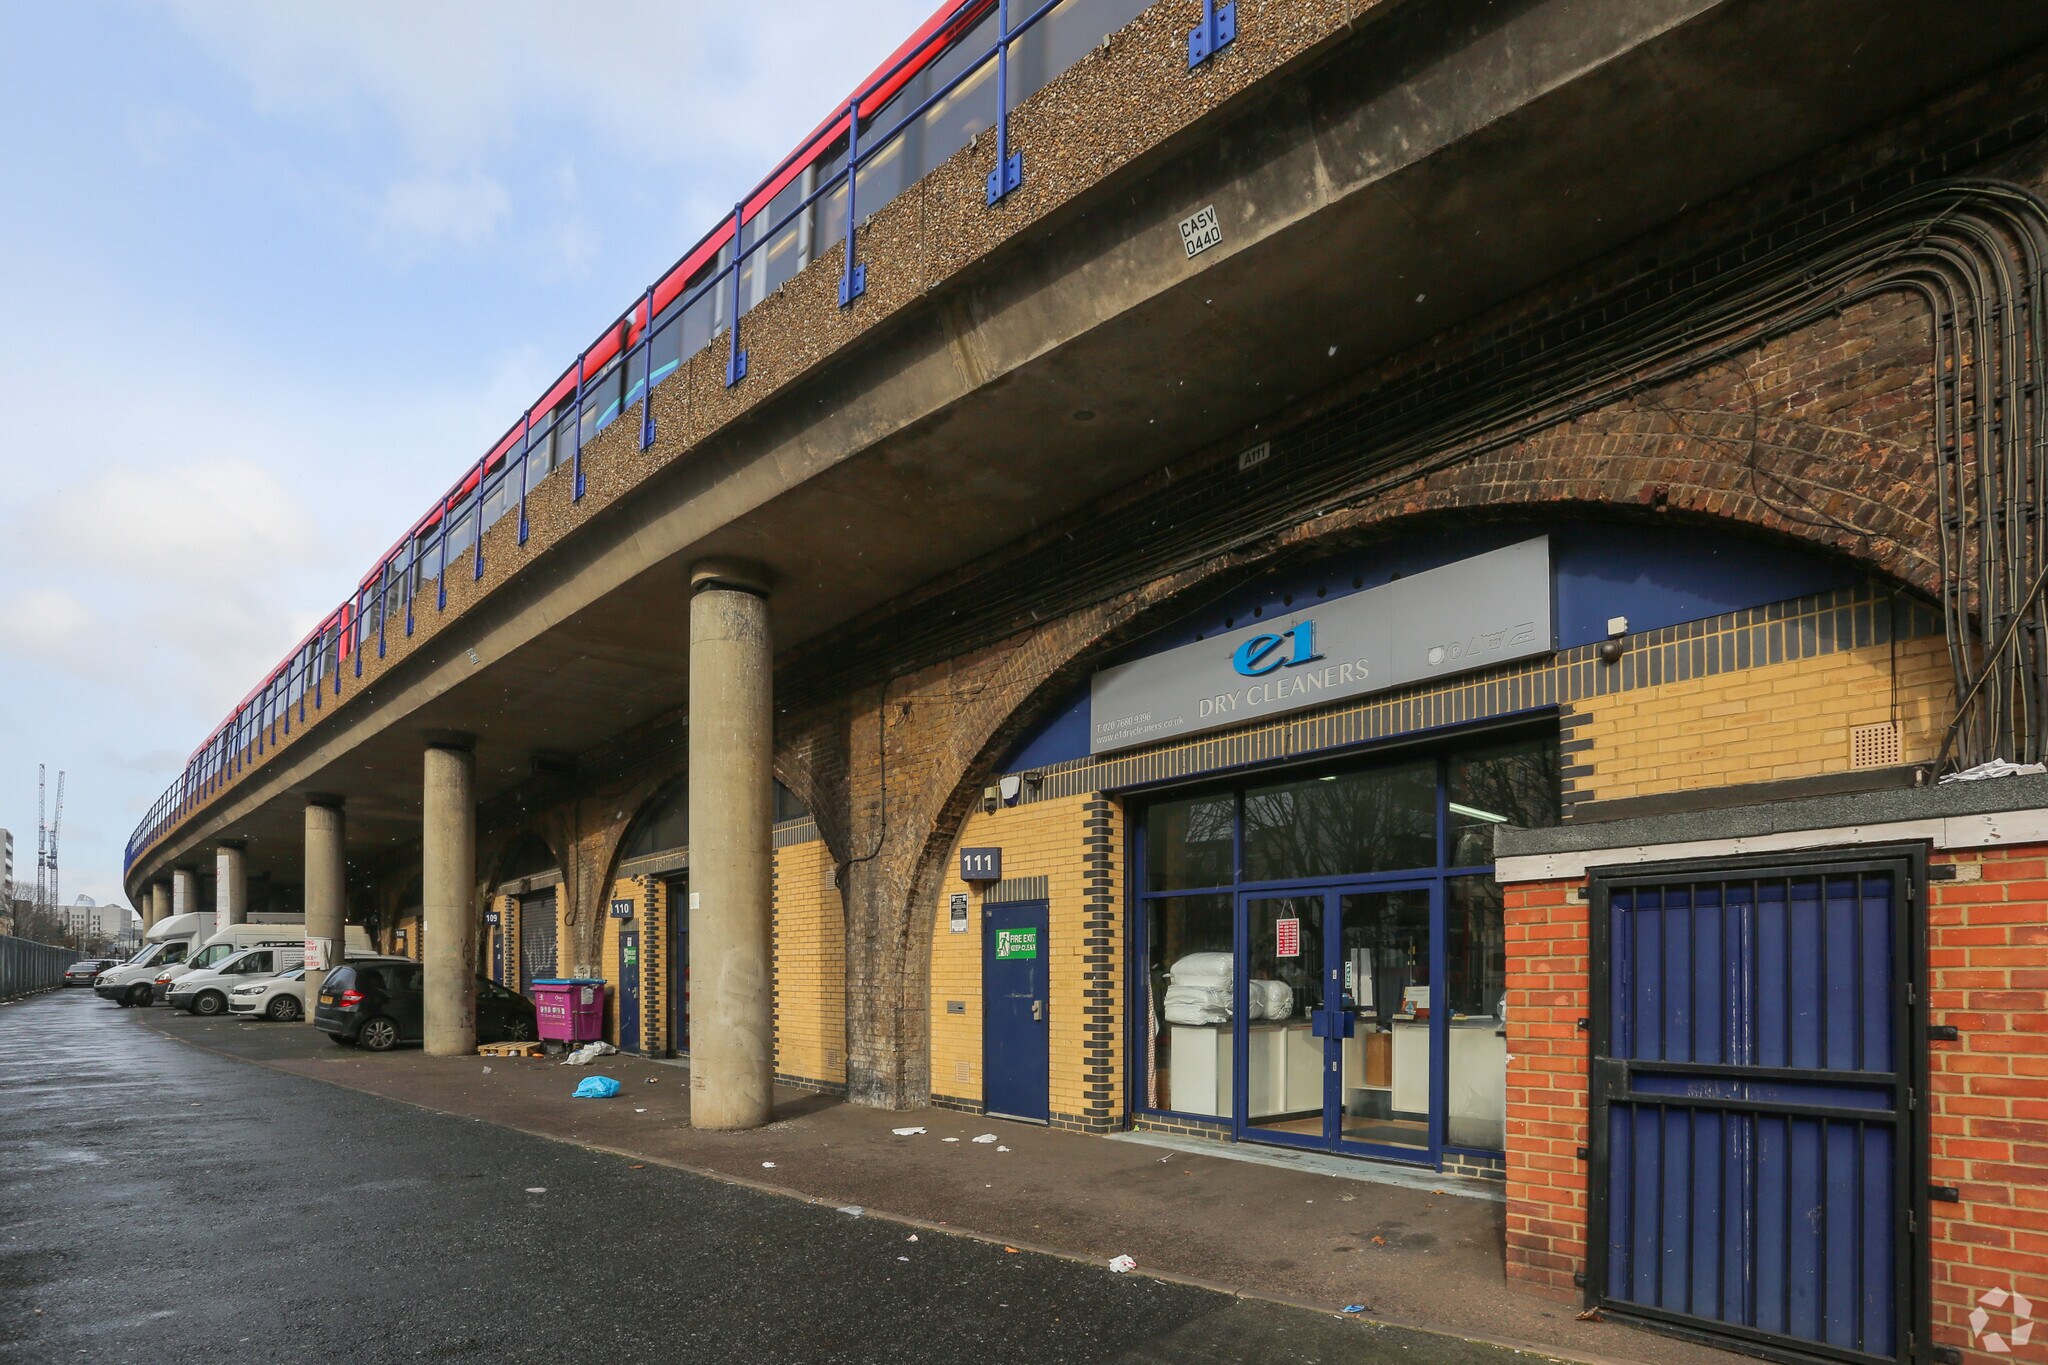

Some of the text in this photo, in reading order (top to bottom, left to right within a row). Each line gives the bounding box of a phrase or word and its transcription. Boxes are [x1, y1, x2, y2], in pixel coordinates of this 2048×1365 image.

[1181, 207, 1215, 238] CASV
[1186, 226, 1220, 255] 0440
[1243, 445, 1266, 467] A111
[1232, 618, 1325, 677] e1
[1199, 658, 1370, 719] DRY CLEANERS
[1096, 715, 1185, 745] www.e1drycleaners.co.uk
[1102, 721, 1116, 733] 020
[1116, 716, 1133, 728] 7680
[1134, 711, 1151, 725] 9396
[963, 854, 992, 871] 111
[486, 914, 498, 922] 109
[614, 903, 629, 914] 110
[1010, 933, 1036, 943] FIRE EXIT
